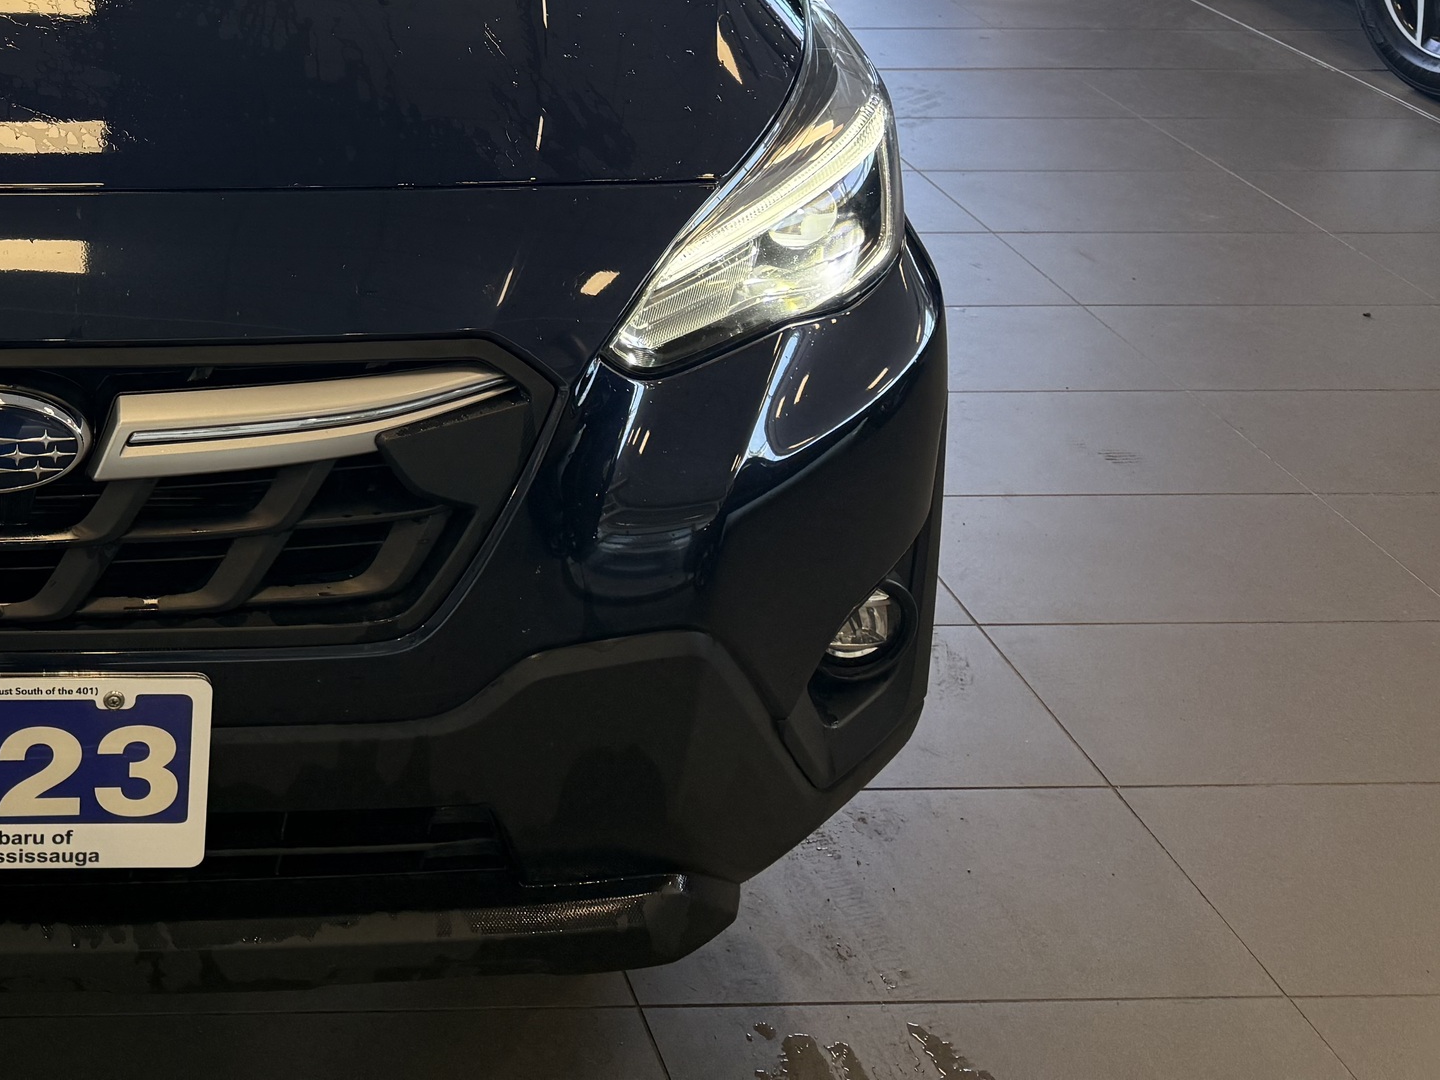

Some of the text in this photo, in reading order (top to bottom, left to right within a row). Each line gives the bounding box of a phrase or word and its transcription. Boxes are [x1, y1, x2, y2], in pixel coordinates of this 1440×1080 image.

[15, 687, 43, 696] South
[45, 686, 56, 695] of
[58, 686, 74, 695] the
[75, 686, 99, 696] 401)
[51, 829, 74, 845] of
